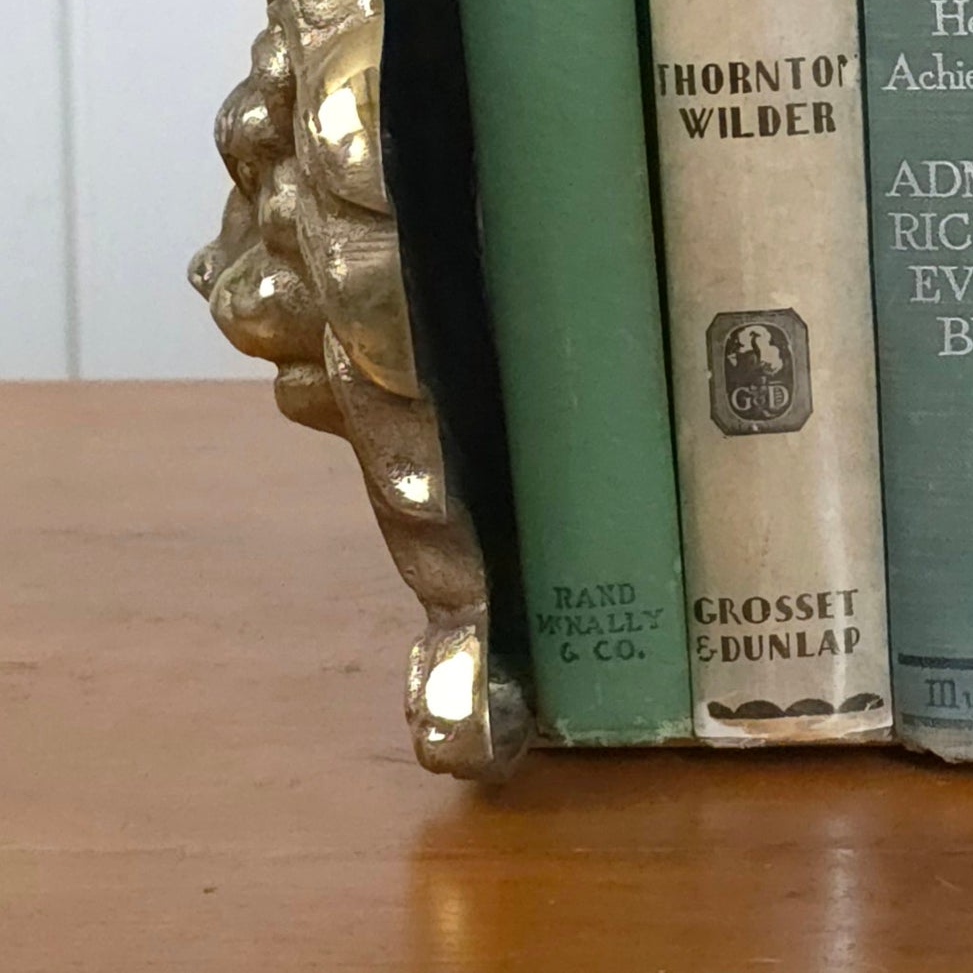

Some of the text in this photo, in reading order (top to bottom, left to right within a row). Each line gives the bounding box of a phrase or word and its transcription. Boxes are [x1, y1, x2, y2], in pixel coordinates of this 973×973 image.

[679, 101, 836, 139] WILDER
[552, 583, 637, 610] RAND
[694, 588, 859, 625] GROSSET
[593, 639, 647, 662] CO.
